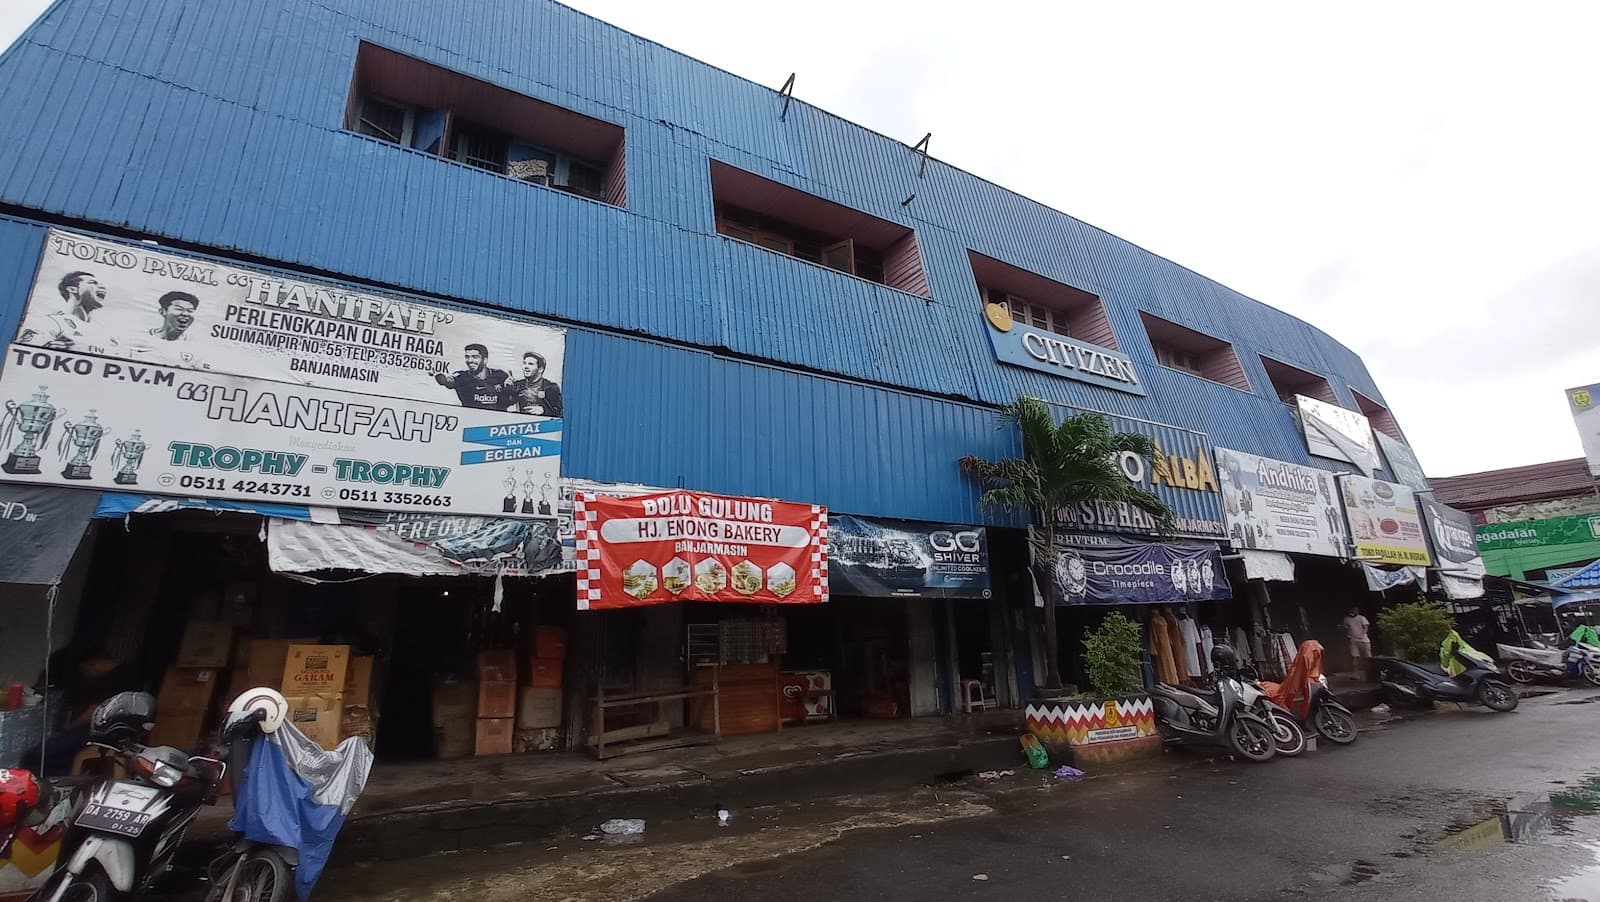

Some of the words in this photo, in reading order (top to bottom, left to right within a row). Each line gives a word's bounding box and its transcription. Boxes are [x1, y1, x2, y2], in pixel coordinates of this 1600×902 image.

[55, 236, 137, 269] TOKO
[143, 256, 219, 286] P.V.M.
[210, 324, 299, 350] SUDIMAMPIR
[301, 339, 322, 355] NO.
[326, 343, 342, 357] 55
[224, 304, 357, 343] PERLENGKAPAN
[362, 328, 401, 350] OLAH
[406, 337, 444, 357] RAGA
[12, 348, 93, 376] TOKO
[102, 363, 175, 387] P.V.M
[1022, 332, 1137, 385] CITIZEN
[290, 358, 380, 383] BANJARMASIN
[490, 423, 541, 437] PARTAI
[168, 440, 308, 477] TROPHY
[333, 458, 451, 489] TROPHY
[485, 446, 541, 461] ECERAN
[1152, 436, 1219, 492] ALBA
[179, 475, 226, 491] 0511
[232, 480, 311, 497] 4243731
[1257, 459, 1316, 496] Andhika
[339, 488, 377, 502] 0511
[384, 491, 452, 507] 3352663
[642, 495, 692, 516] BOLU
[698, 497, 773, 522] GULUNG
[638, 521, 661, 537] HJ.
[667, 520, 718, 537] ENONG
[724, 524, 781, 542] BAKERY
[1475, 528, 1537, 543] egadaian
[675, 541, 748, 556] BANJARMASIN
[934, 552, 980, 563] SHIVER
[1093, 561, 1164, 575] Crocodile
[1112, 580, 1154, 588] Timepiece
[294, 673, 334, 681] GARAM
[86, 805, 101, 816] DA
[103, 808, 131, 821] 2759
[133, 814, 149, 824] AR
